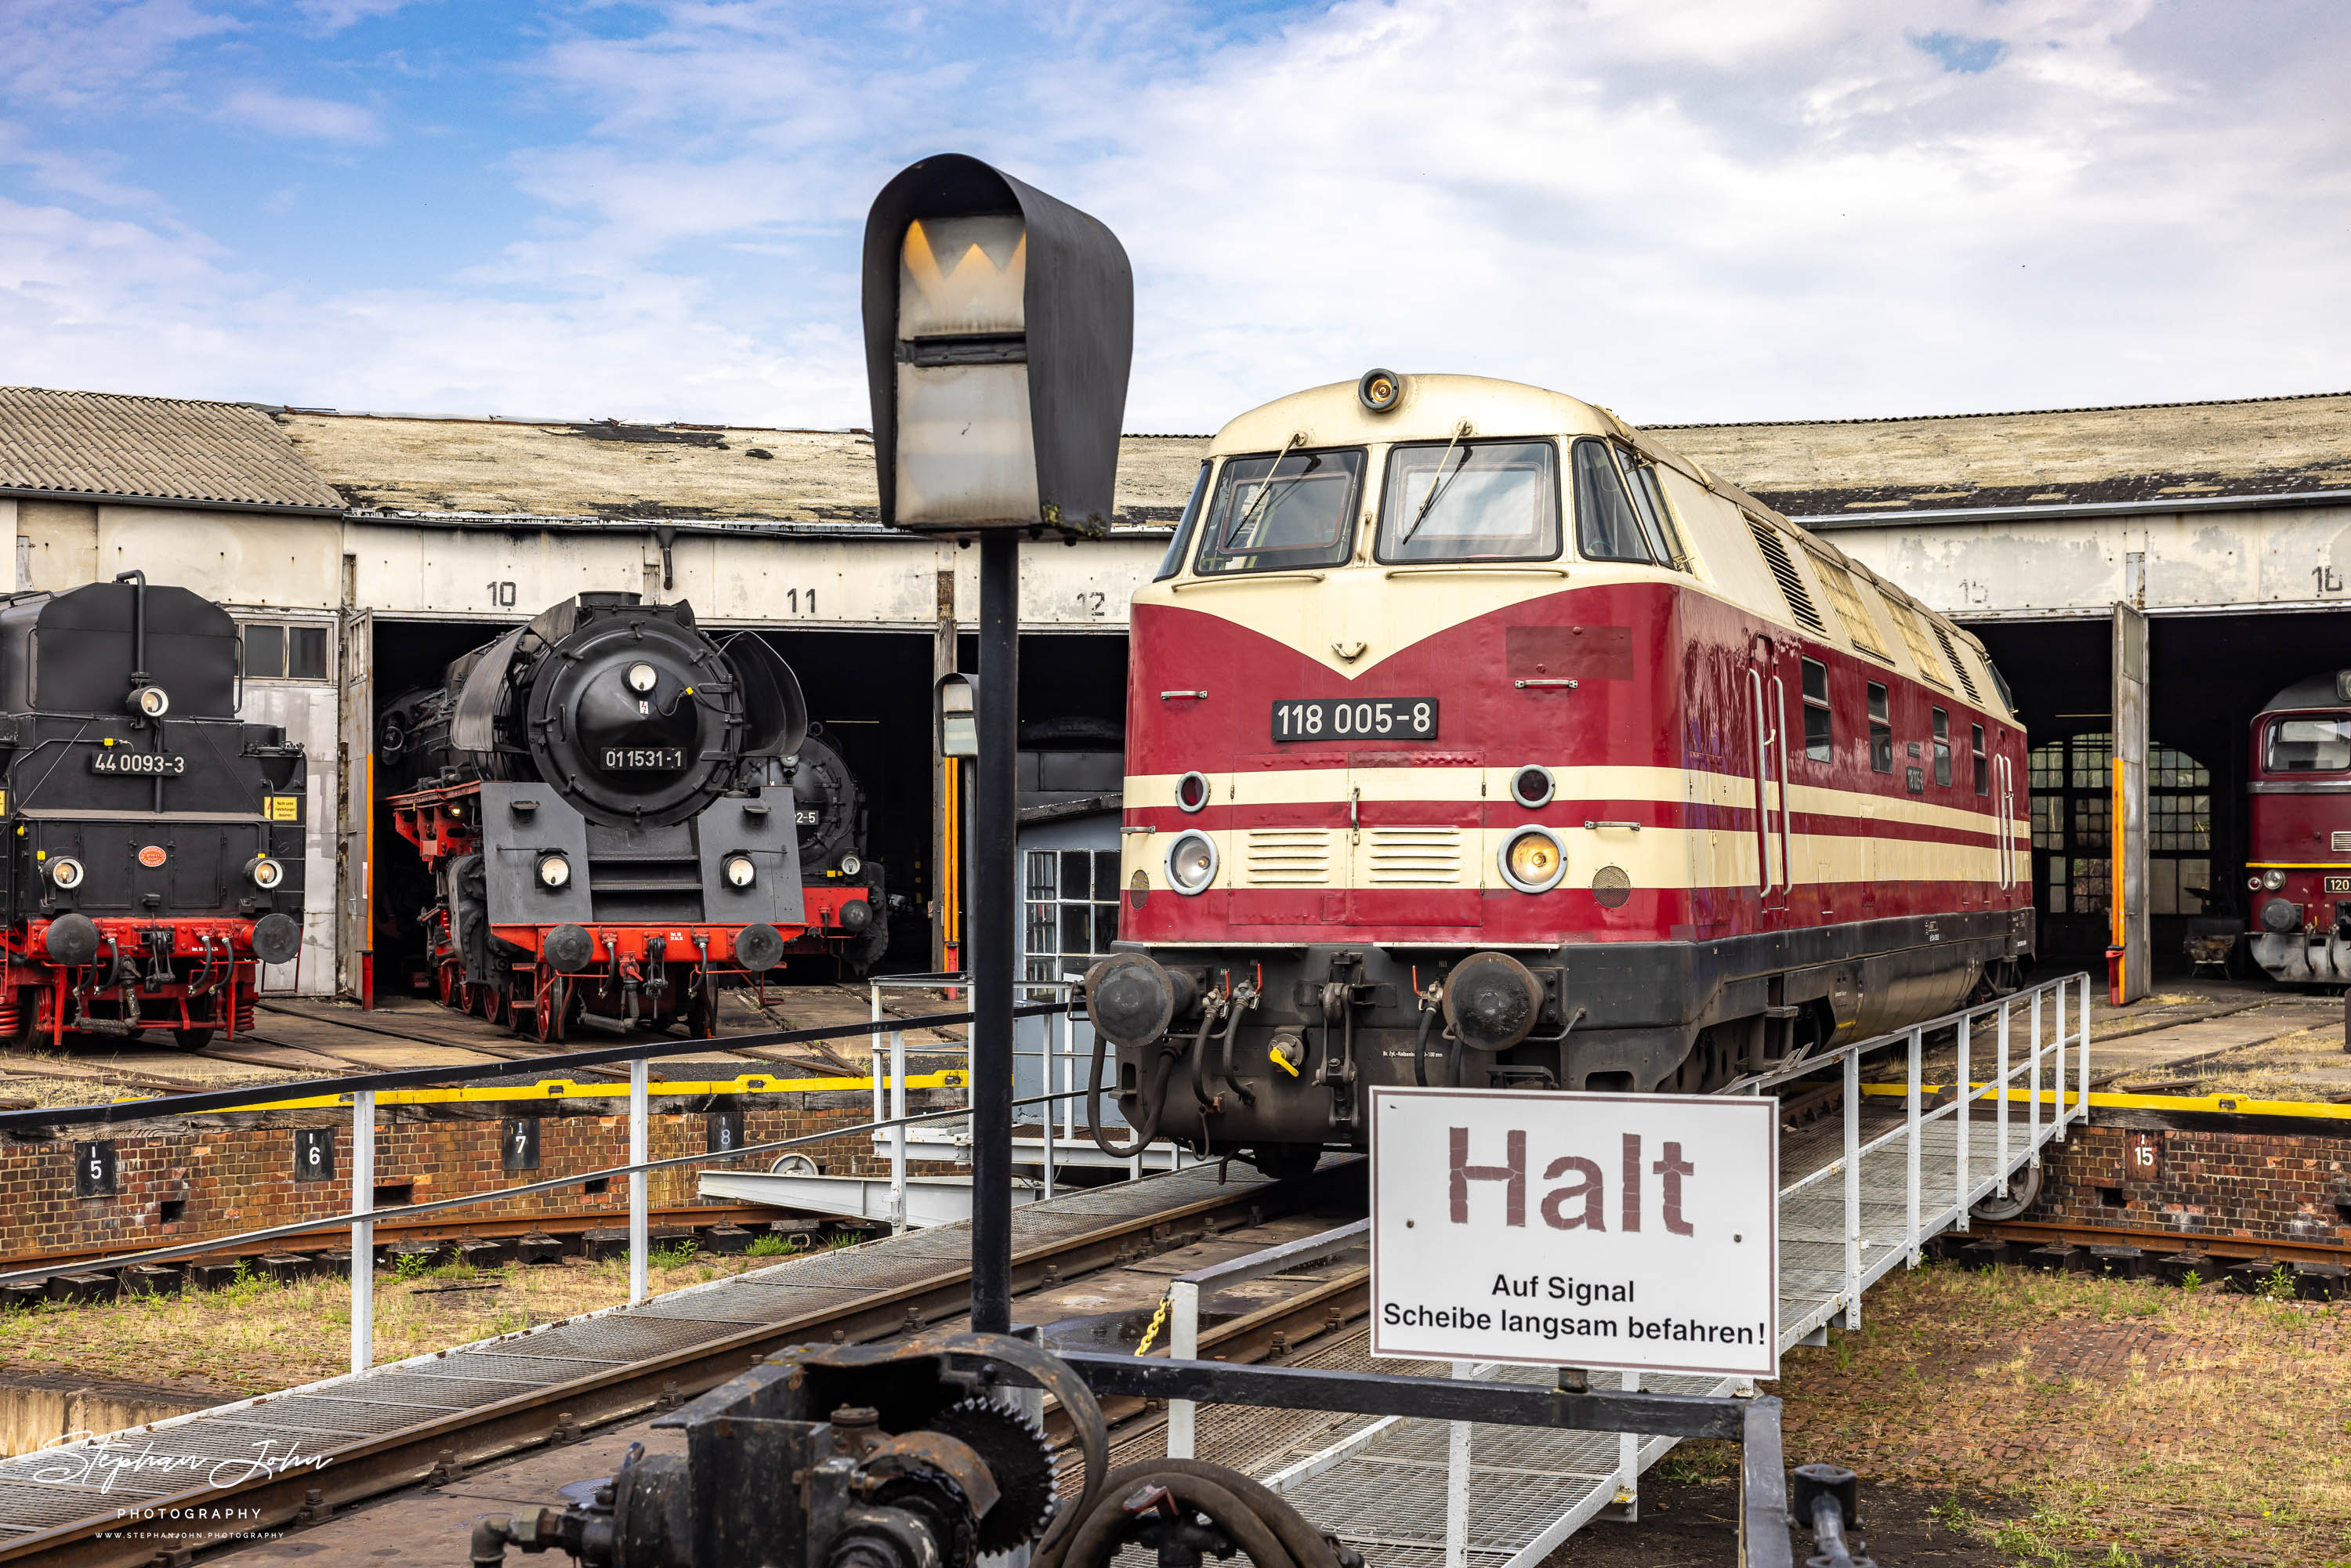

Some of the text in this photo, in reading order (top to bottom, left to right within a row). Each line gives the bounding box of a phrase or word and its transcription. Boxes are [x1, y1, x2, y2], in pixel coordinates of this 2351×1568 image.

[487, 581, 516, 607] 10
[787, 588, 816, 613] 11
[1077, 592, 1105, 617] 12
[1277, 702, 1430, 735] 118 005-8
[95, 753, 185, 773] 44 0093-3
[795, 812, 816, 824] 2-5
[2330, 879, 2349, 891] 120
[515, 1135, 527, 1153] 7
[721, 1128, 730, 1145] 8
[309, 1146, 321, 1165] 6
[2134, 1146, 2154, 1166] 15
[90, 1160, 102, 1179] 5
[1449, 1126, 1694, 1237] Halt
[1491, 1274, 1634, 1306] Auf Signal
[1384, 1302, 1765, 1345] Scheibe langsam befahren!
